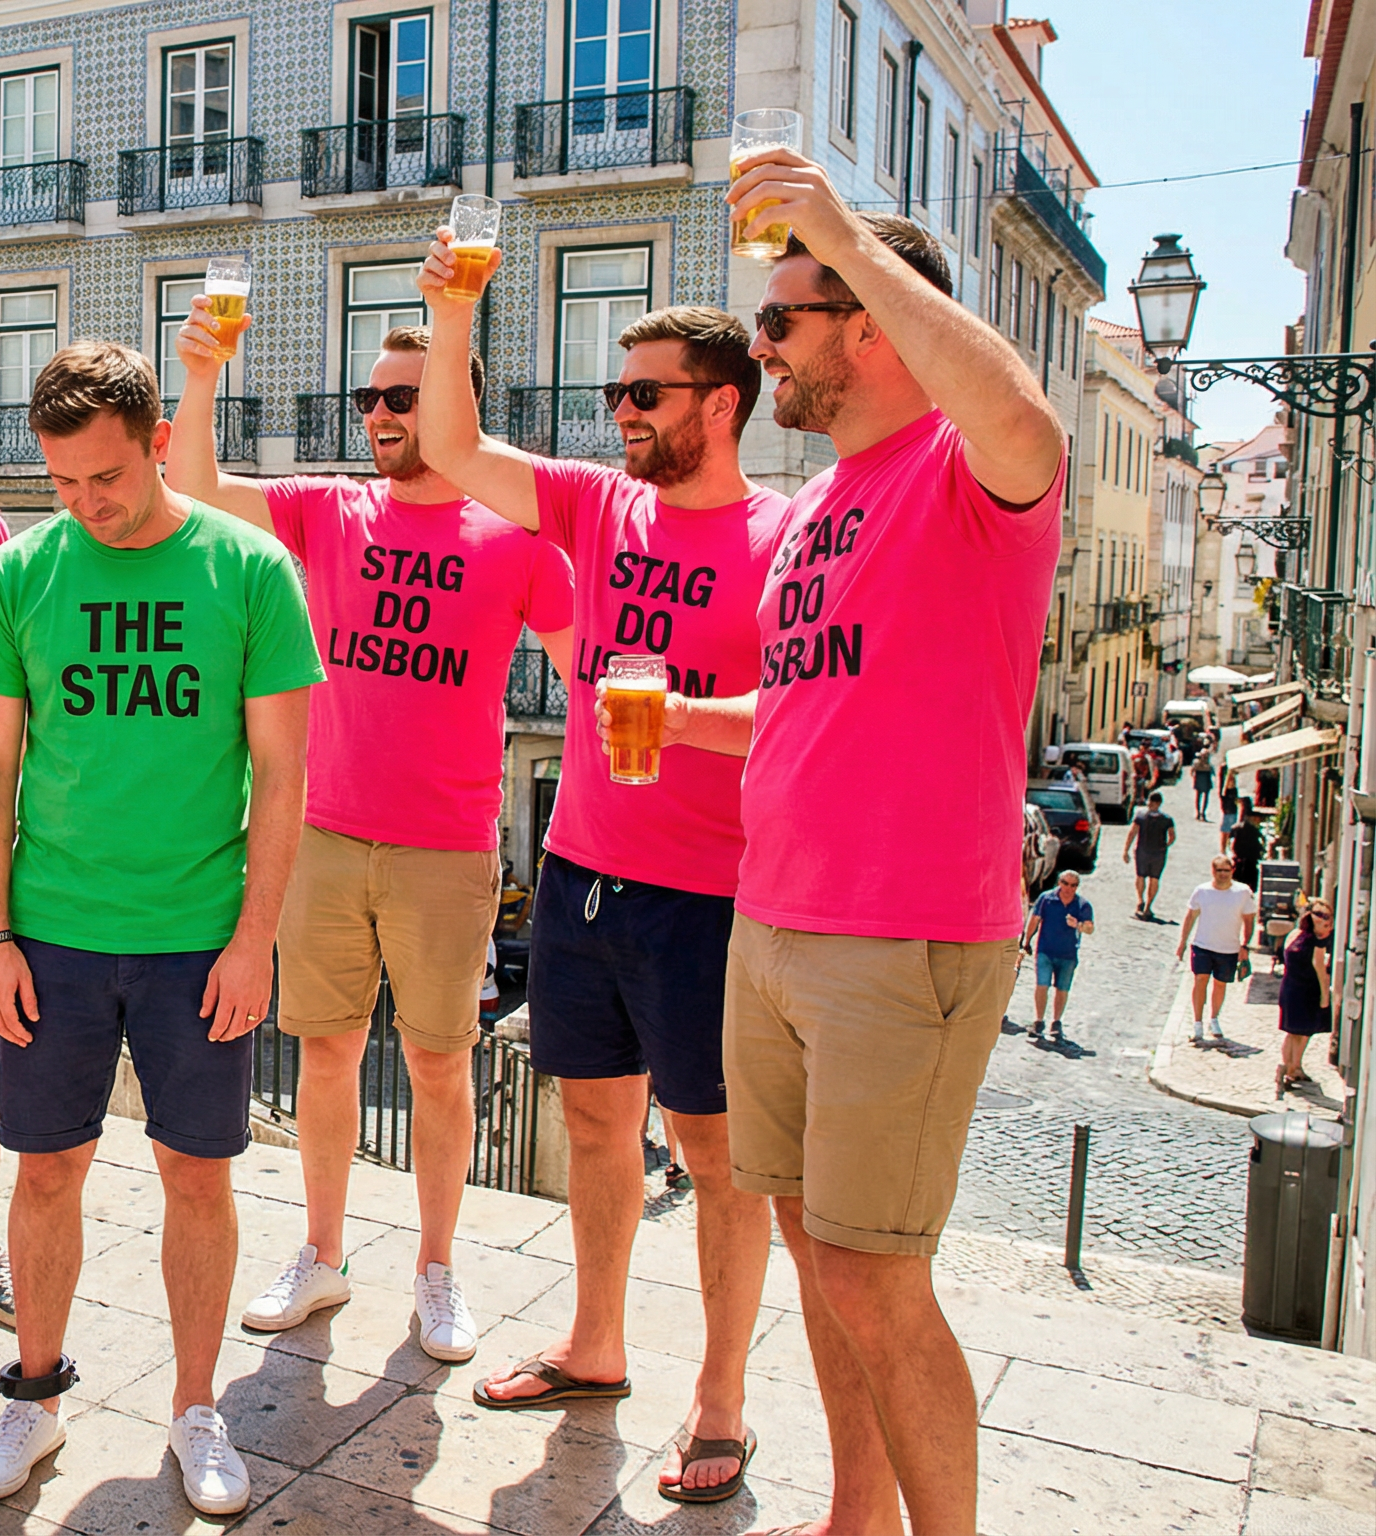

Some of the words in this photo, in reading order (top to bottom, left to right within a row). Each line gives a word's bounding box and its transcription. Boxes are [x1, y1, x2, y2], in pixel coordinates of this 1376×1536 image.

[360, 545, 465, 593] STAG
[774, 508, 864, 576] STAG
[609, 551, 716, 608] STAG
[779, 574, 825, 630] DO
[80, 602, 184, 653] THE
[373, 591, 430, 634] DO
[615, 602, 673, 655] DO
[329, 628, 469, 687] LISBON
[61, 664, 200, 718] STAG
